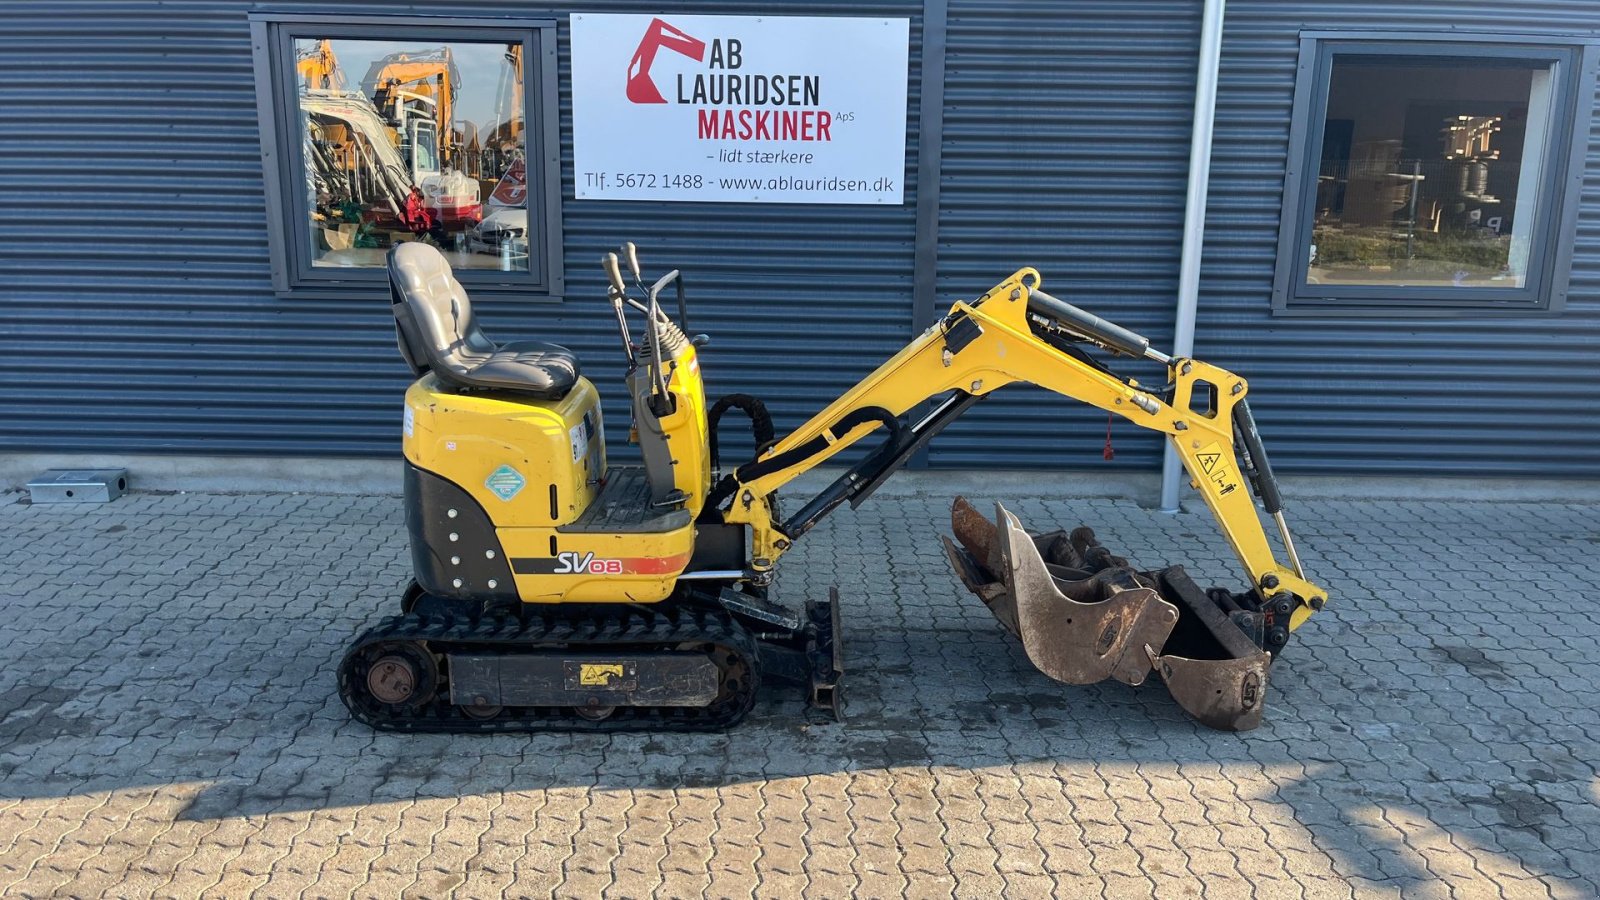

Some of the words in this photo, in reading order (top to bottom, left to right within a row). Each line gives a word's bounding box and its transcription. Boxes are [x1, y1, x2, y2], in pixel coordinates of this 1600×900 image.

[709, 38, 742, 69] AB
[677, 73, 819, 106] LAURIDSEN
[698, 109, 832, 141] MASKINER
[835, 111, 855, 123] ApS
[718, 149, 743, 163] lidt
[746, 149, 814, 164] stærkere
[584, 172, 610, 191] Tlf.
[616, 173, 657, 188] 5672
[662, 174, 703, 189] 1488
[719, 175, 894, 192] www.ablauridsen.dk
